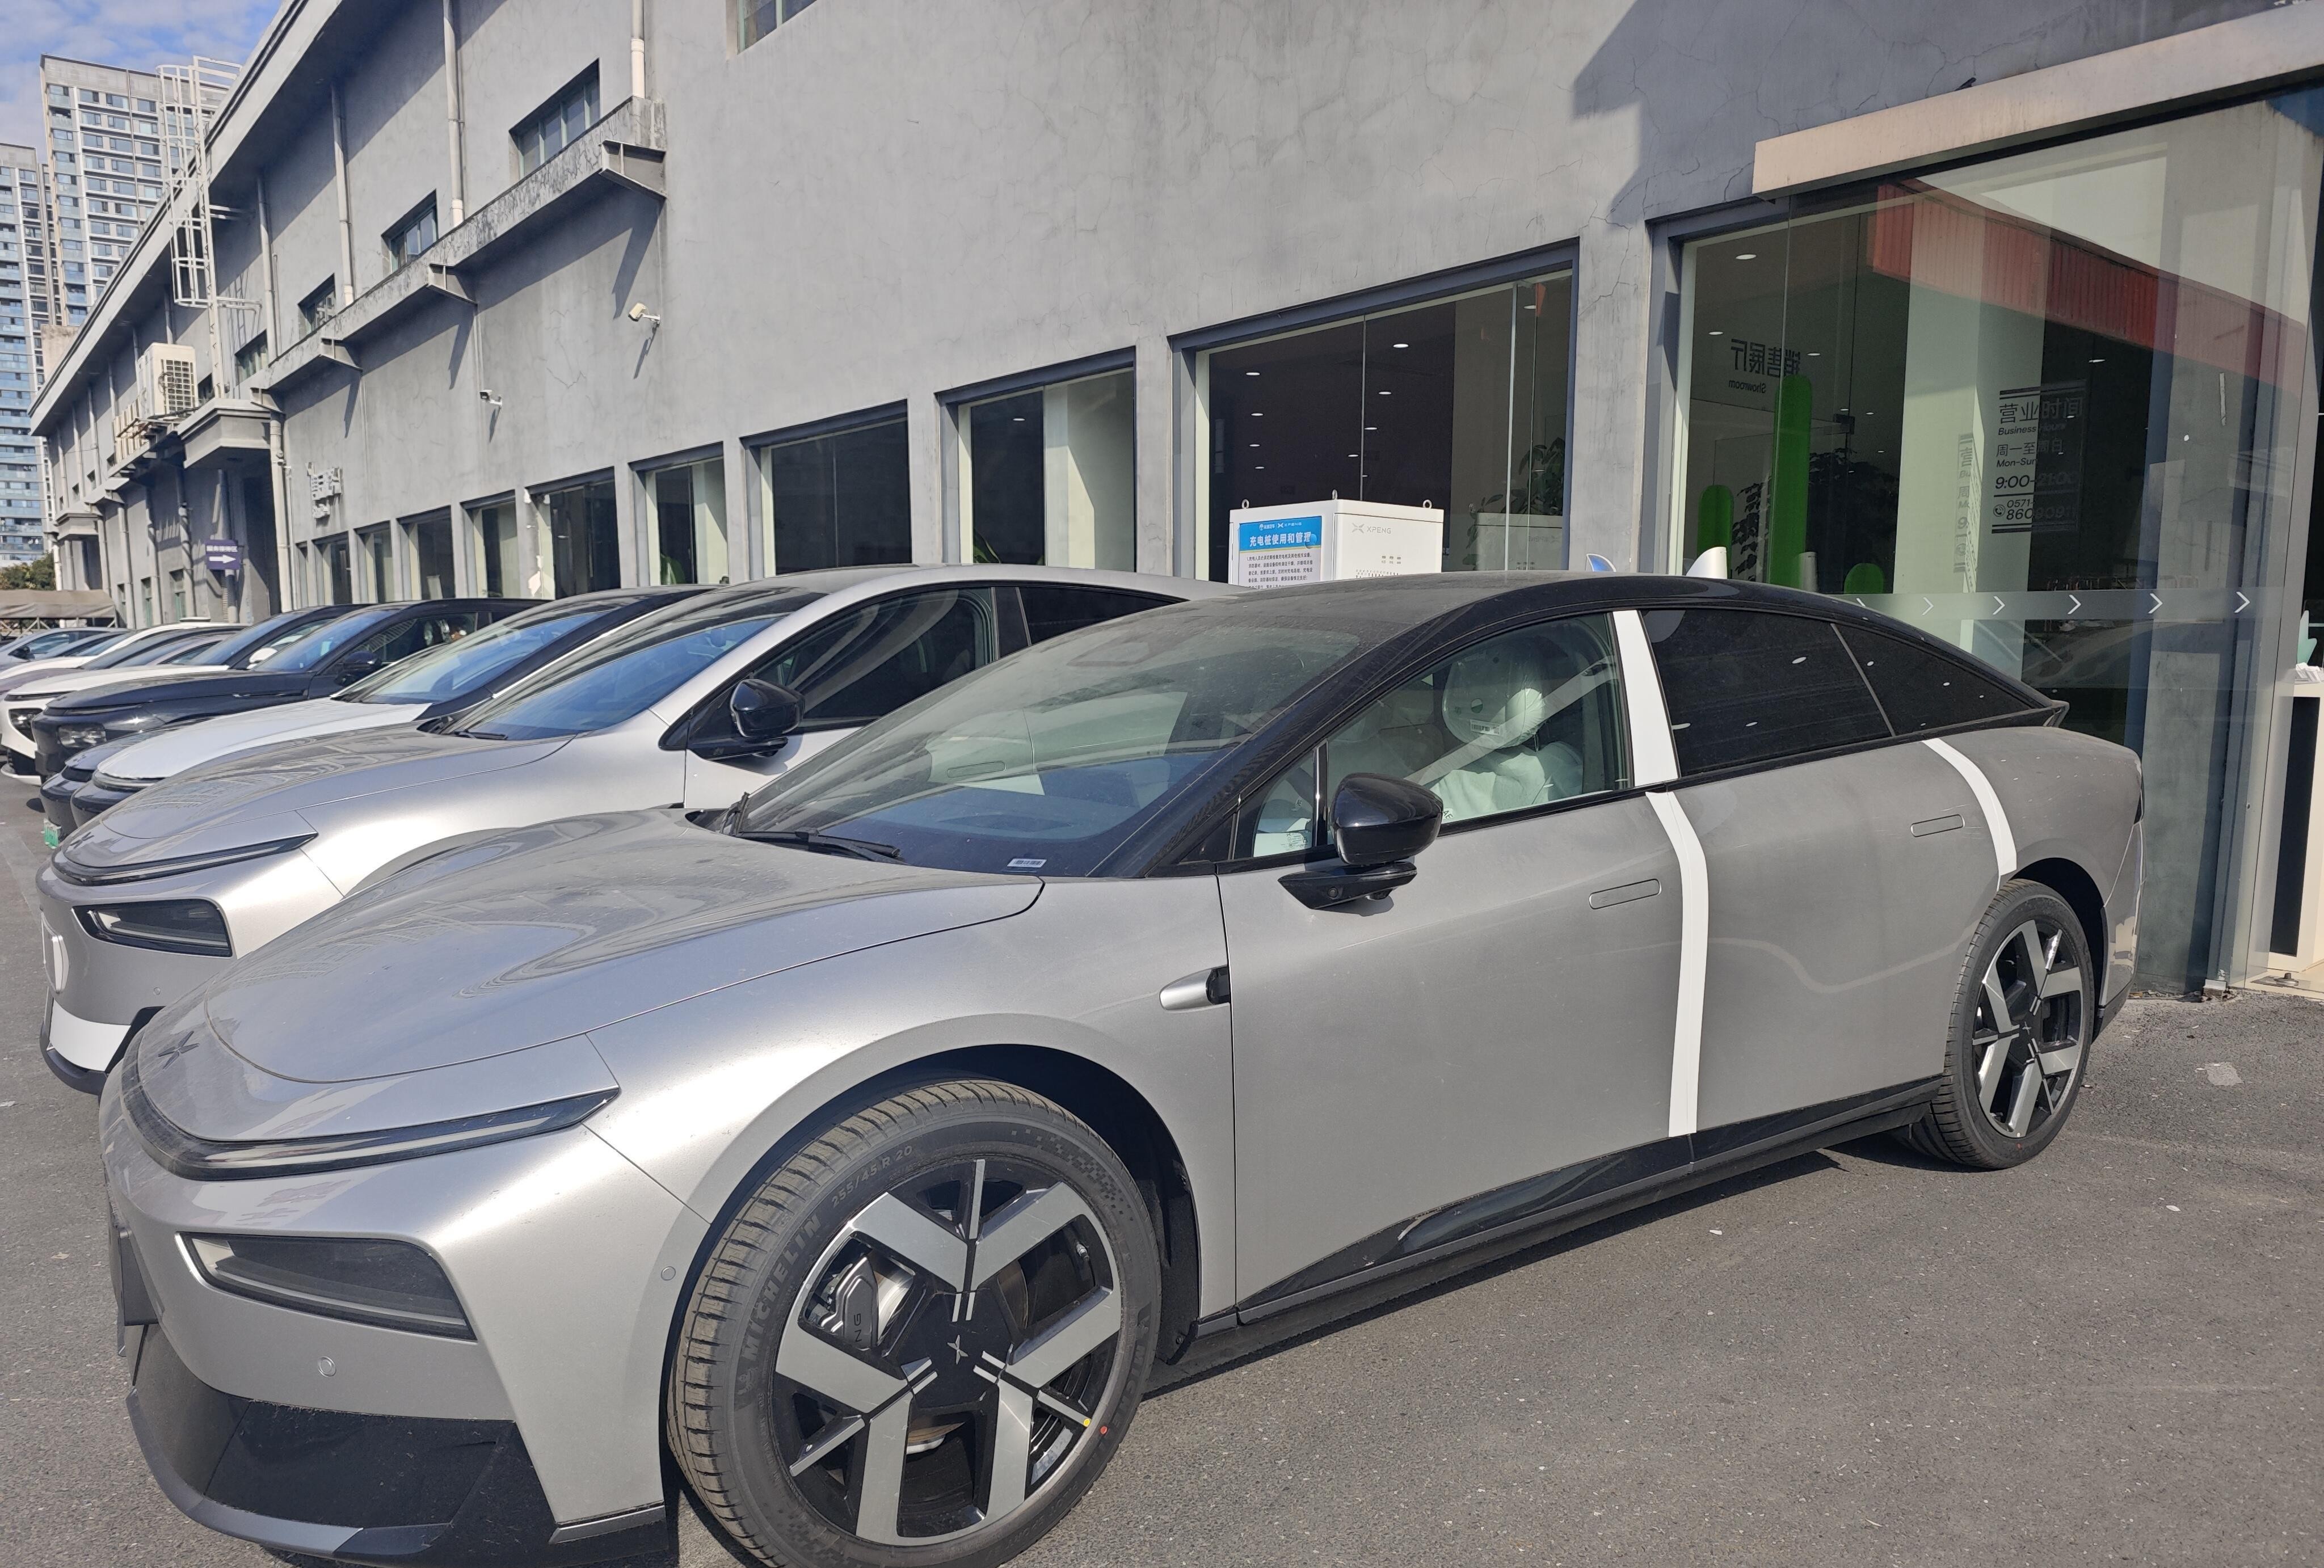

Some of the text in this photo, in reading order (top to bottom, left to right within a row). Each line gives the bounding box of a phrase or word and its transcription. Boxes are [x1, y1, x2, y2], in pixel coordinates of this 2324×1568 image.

[1999, 398, 2083, 424] 营业时间
[1998, 426, 2037, 436] Business
[1249, 532, 1311, 547] 充电桩使用和管理
[1366, 526, 1392, 534] XPENG
[830, 1161, 879, 1209] 255/45
[880, 1156, 891, 1169] R
[895, 1145, 913, 1162] 20
[741, 1213, 823, 1362] MICHELIN
